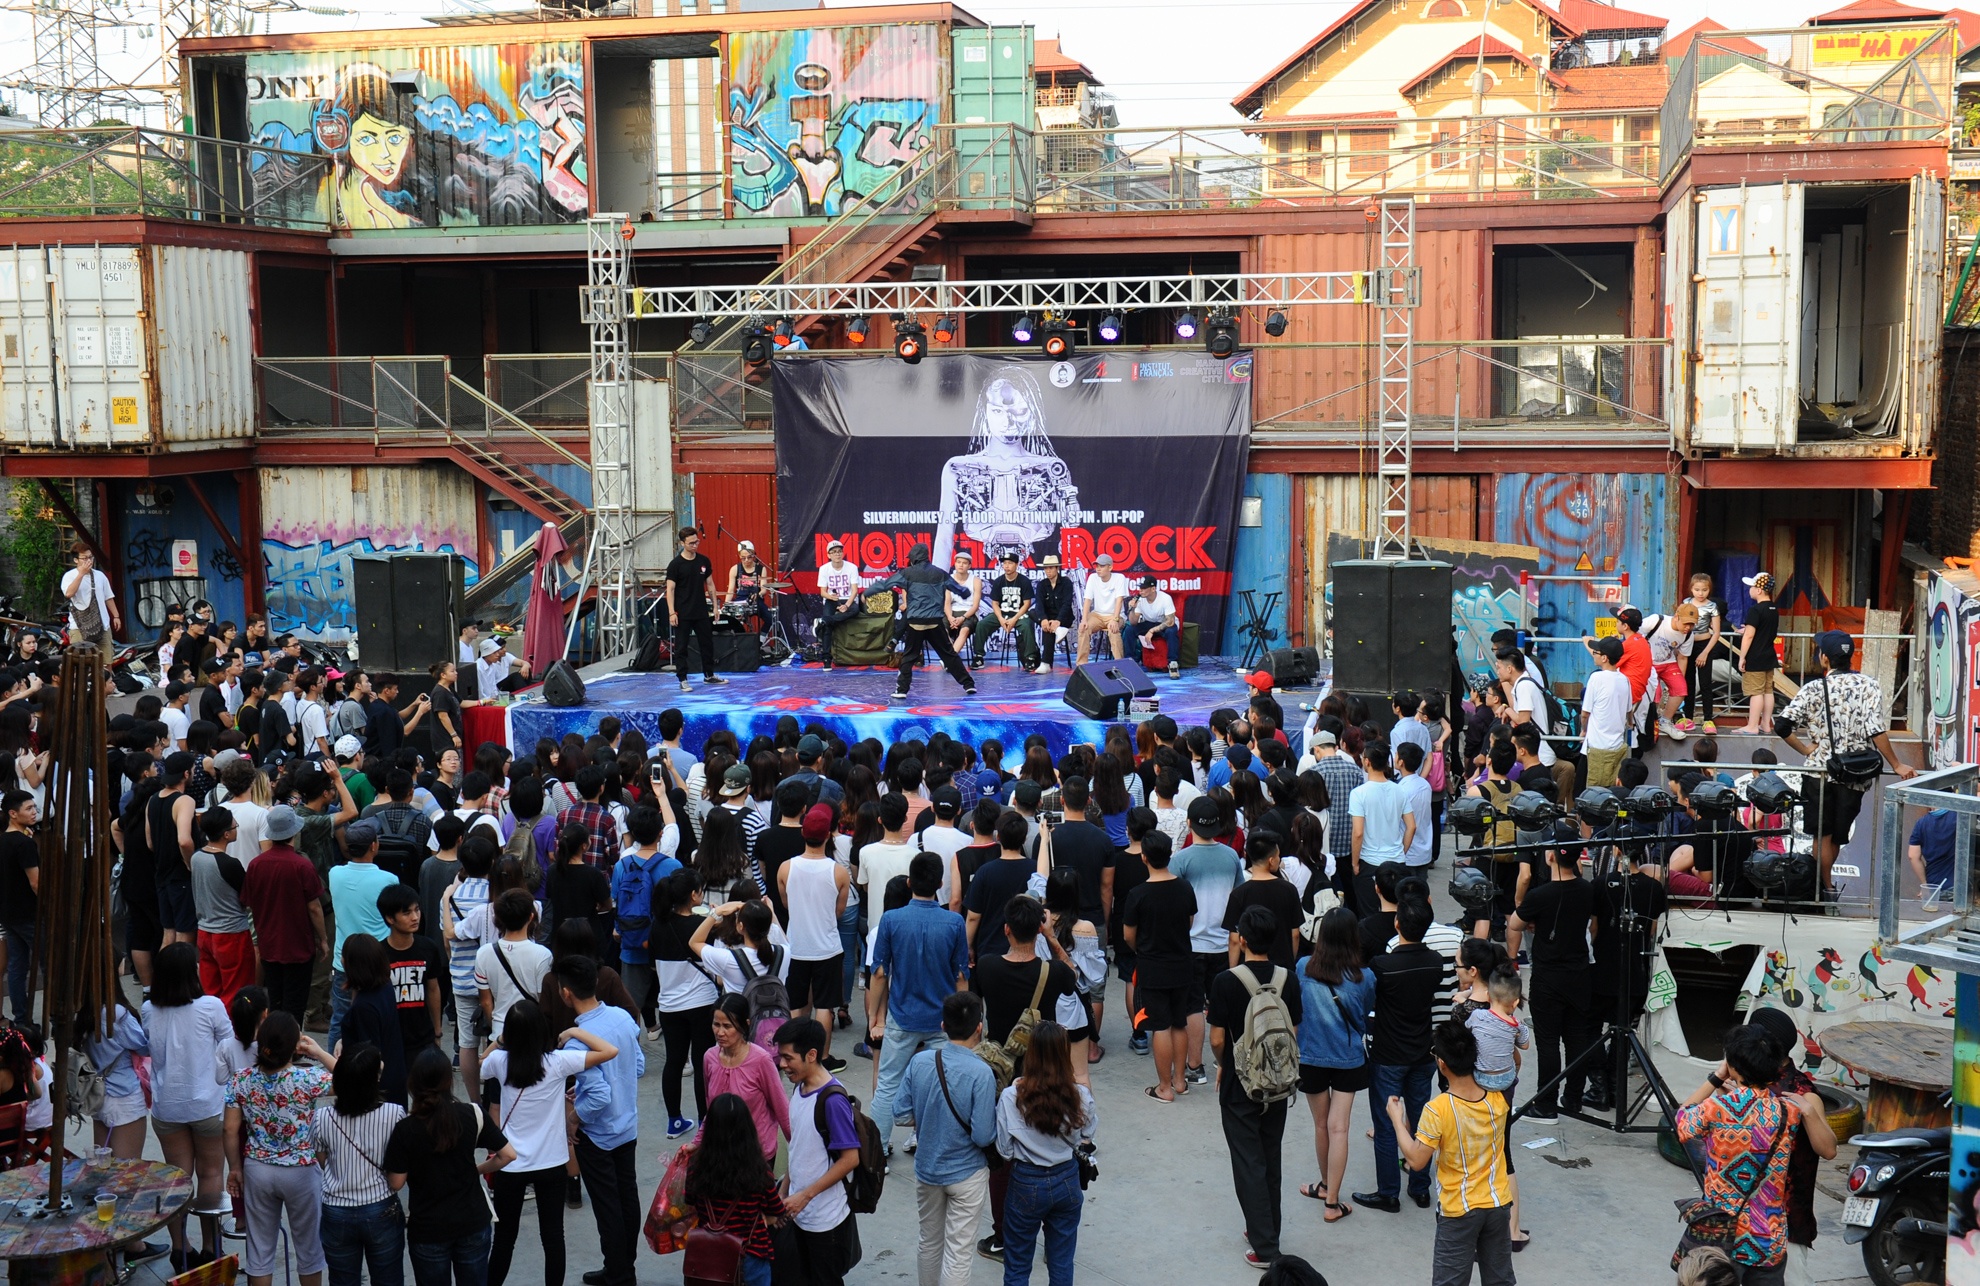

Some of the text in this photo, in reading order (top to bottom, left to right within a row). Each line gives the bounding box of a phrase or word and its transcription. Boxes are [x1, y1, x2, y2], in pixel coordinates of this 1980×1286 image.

[76, 262, 96, 270] YMLU
[104, 273, 122, 282] 45G1
[1140, 362, 1170, 370] INSTITUT
[1140, 369, 1174, 378] FRANÇAIS
[1202, 375, 1222, 383] CITY
[863, 511, 944, 524] SILVERMONKEY
[950, 511, 996, 524] C-FLOOR
[1069, 510, 1094, 524] SPIN
[1102, 510, 1144, 524] MT-POP
[1061, 525, 1217, 571] ROCK
[828, 574, 850, 587] SPR
[1170, 577, 1201, 590] Band
[1001, 595, 1021, 612] 23
[390, 966, 426, 986] VIET
[1844, 1210, 1868, 1224] 3384
